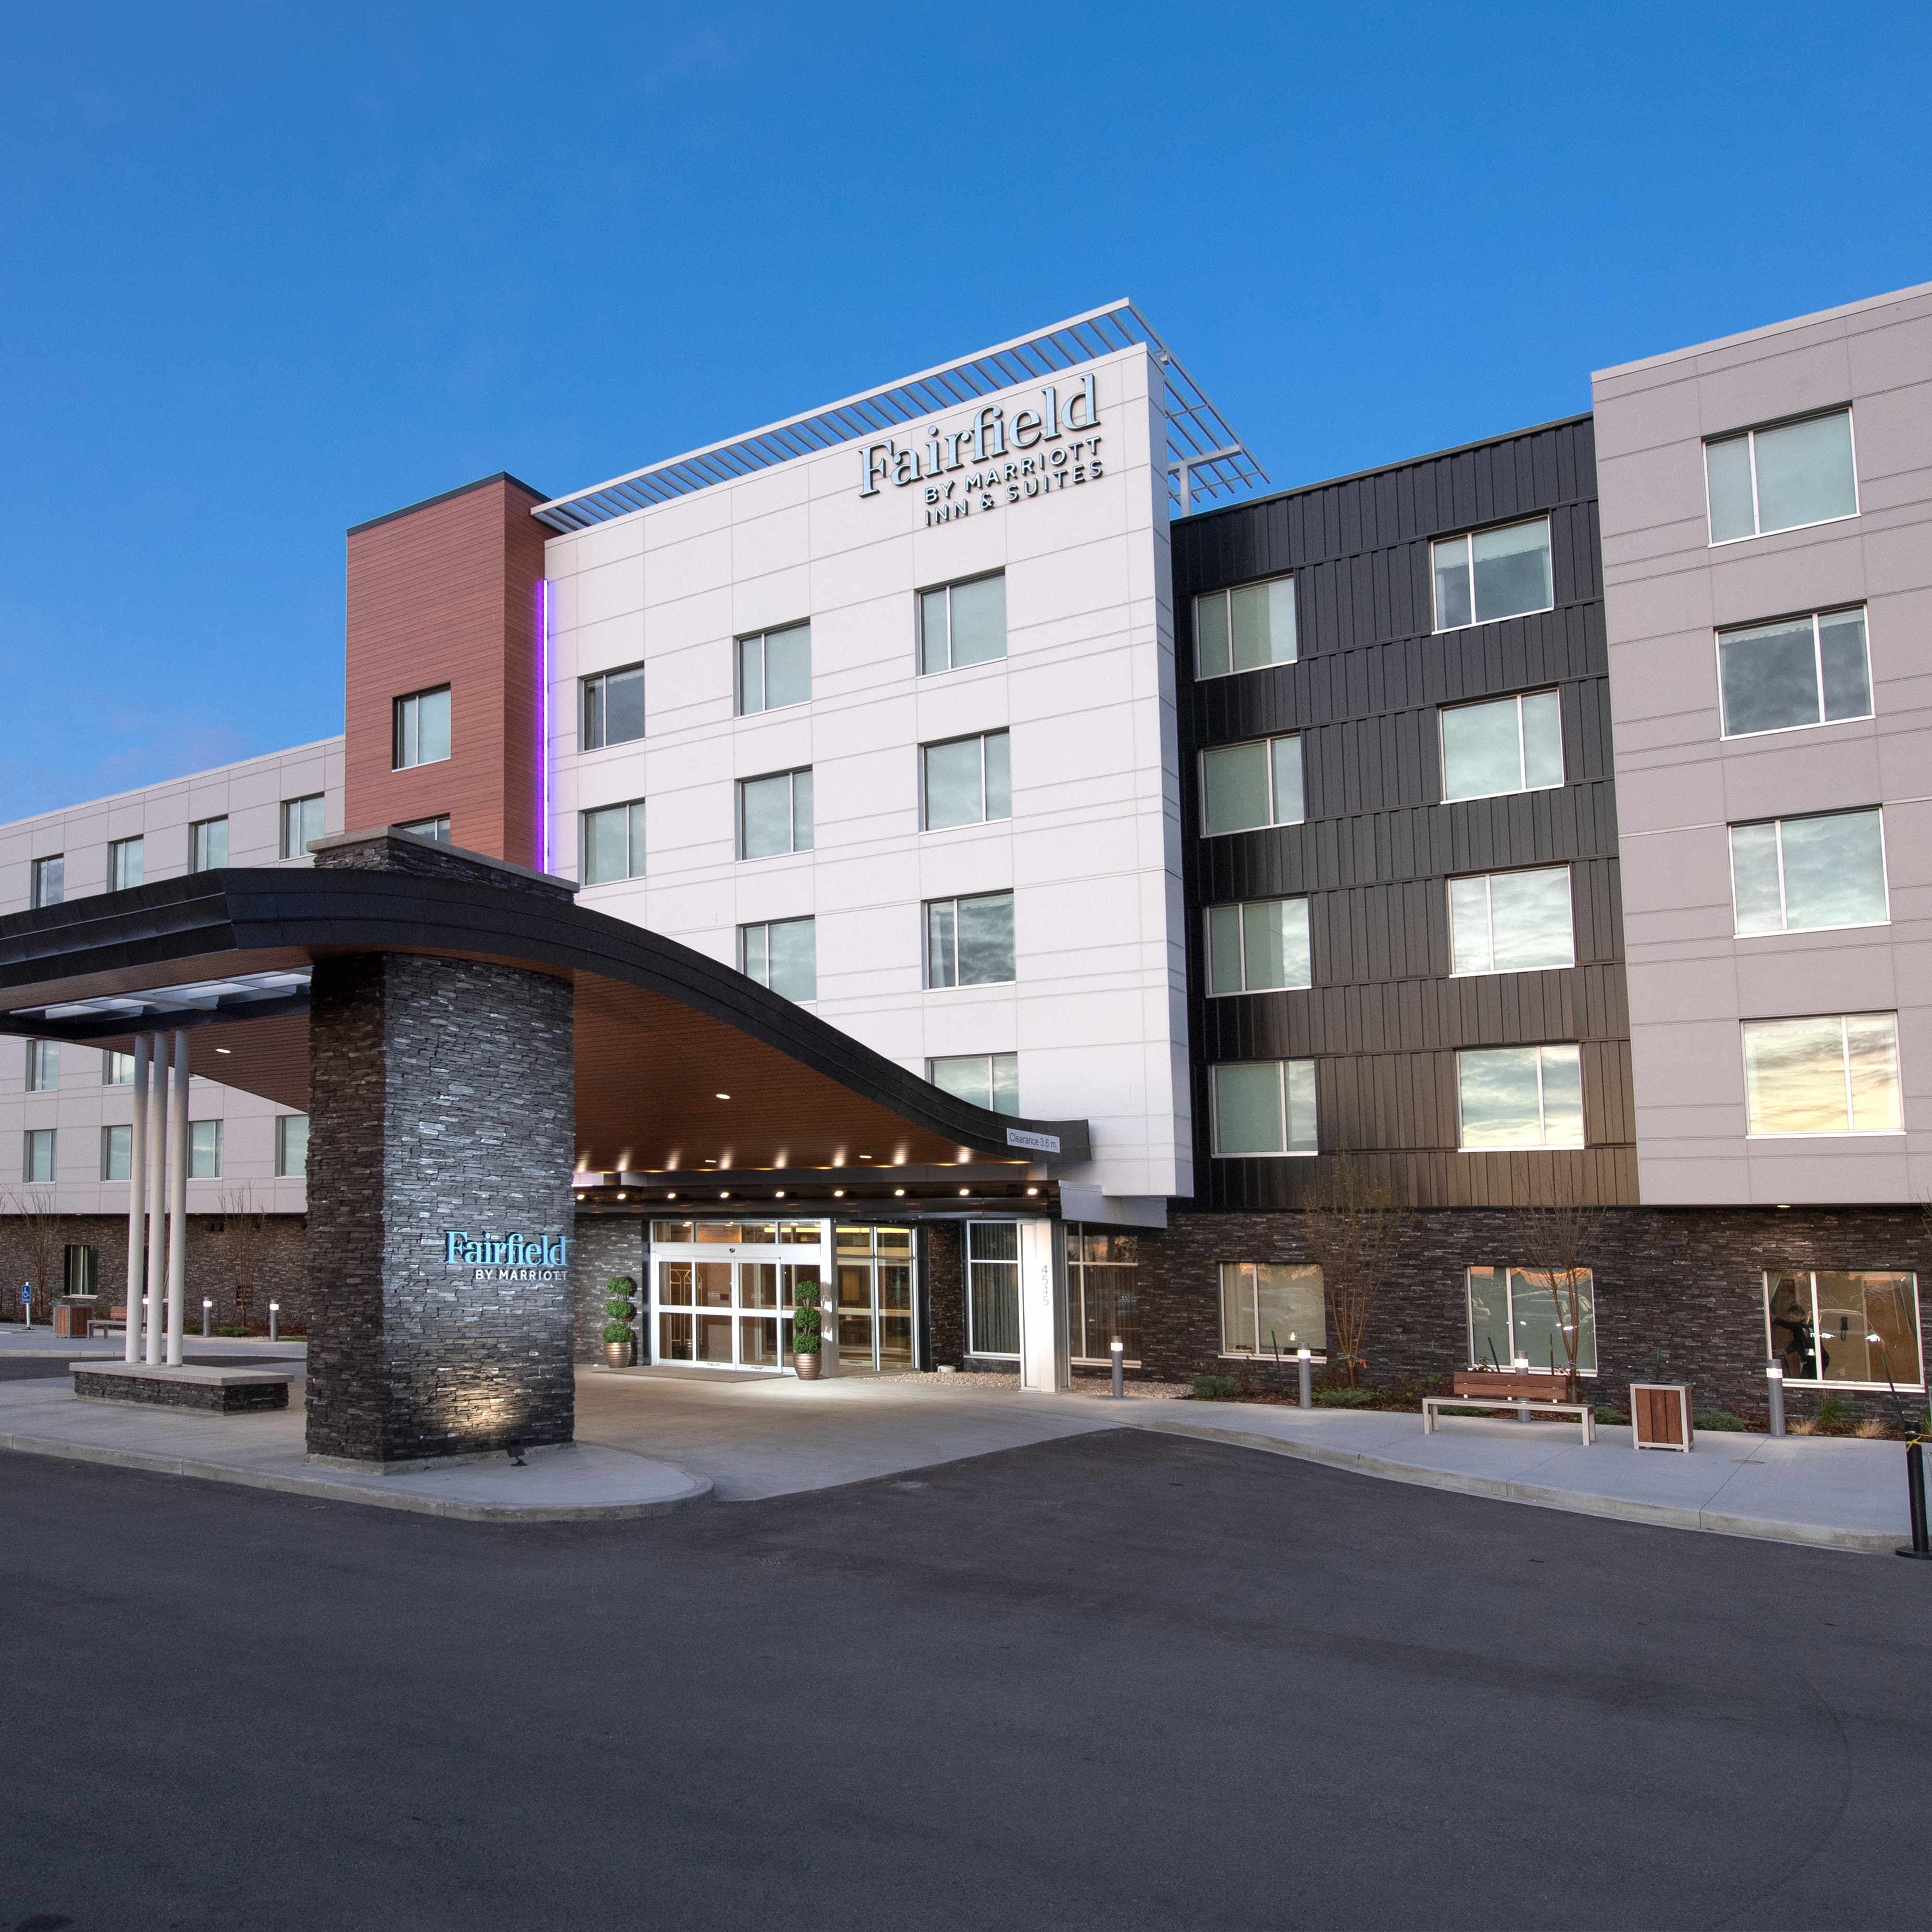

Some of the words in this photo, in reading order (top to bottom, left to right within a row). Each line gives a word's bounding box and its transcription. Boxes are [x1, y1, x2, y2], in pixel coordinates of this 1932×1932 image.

[858, 373, 1101, 498] Fairfield
[925, 480, 955, 504] BY
[965, 436, 1101, 492] MARRIOTT
[925, 499, 968, 527] INN
[980, 492, 995, 510] &
[1007, 460, 1103, 503] SUITES
[1010, 1132, 1039, 1146] Clearance
[1040, 1138, 1049, 1148] 3.6
[444, 1230, 567, 1266] Fairfield
[476, 1269, 493, 1280] BY
[499, 1270, 568, 1281] MARRIOTT
[1041, 1264, 1049, 1306] 4545
